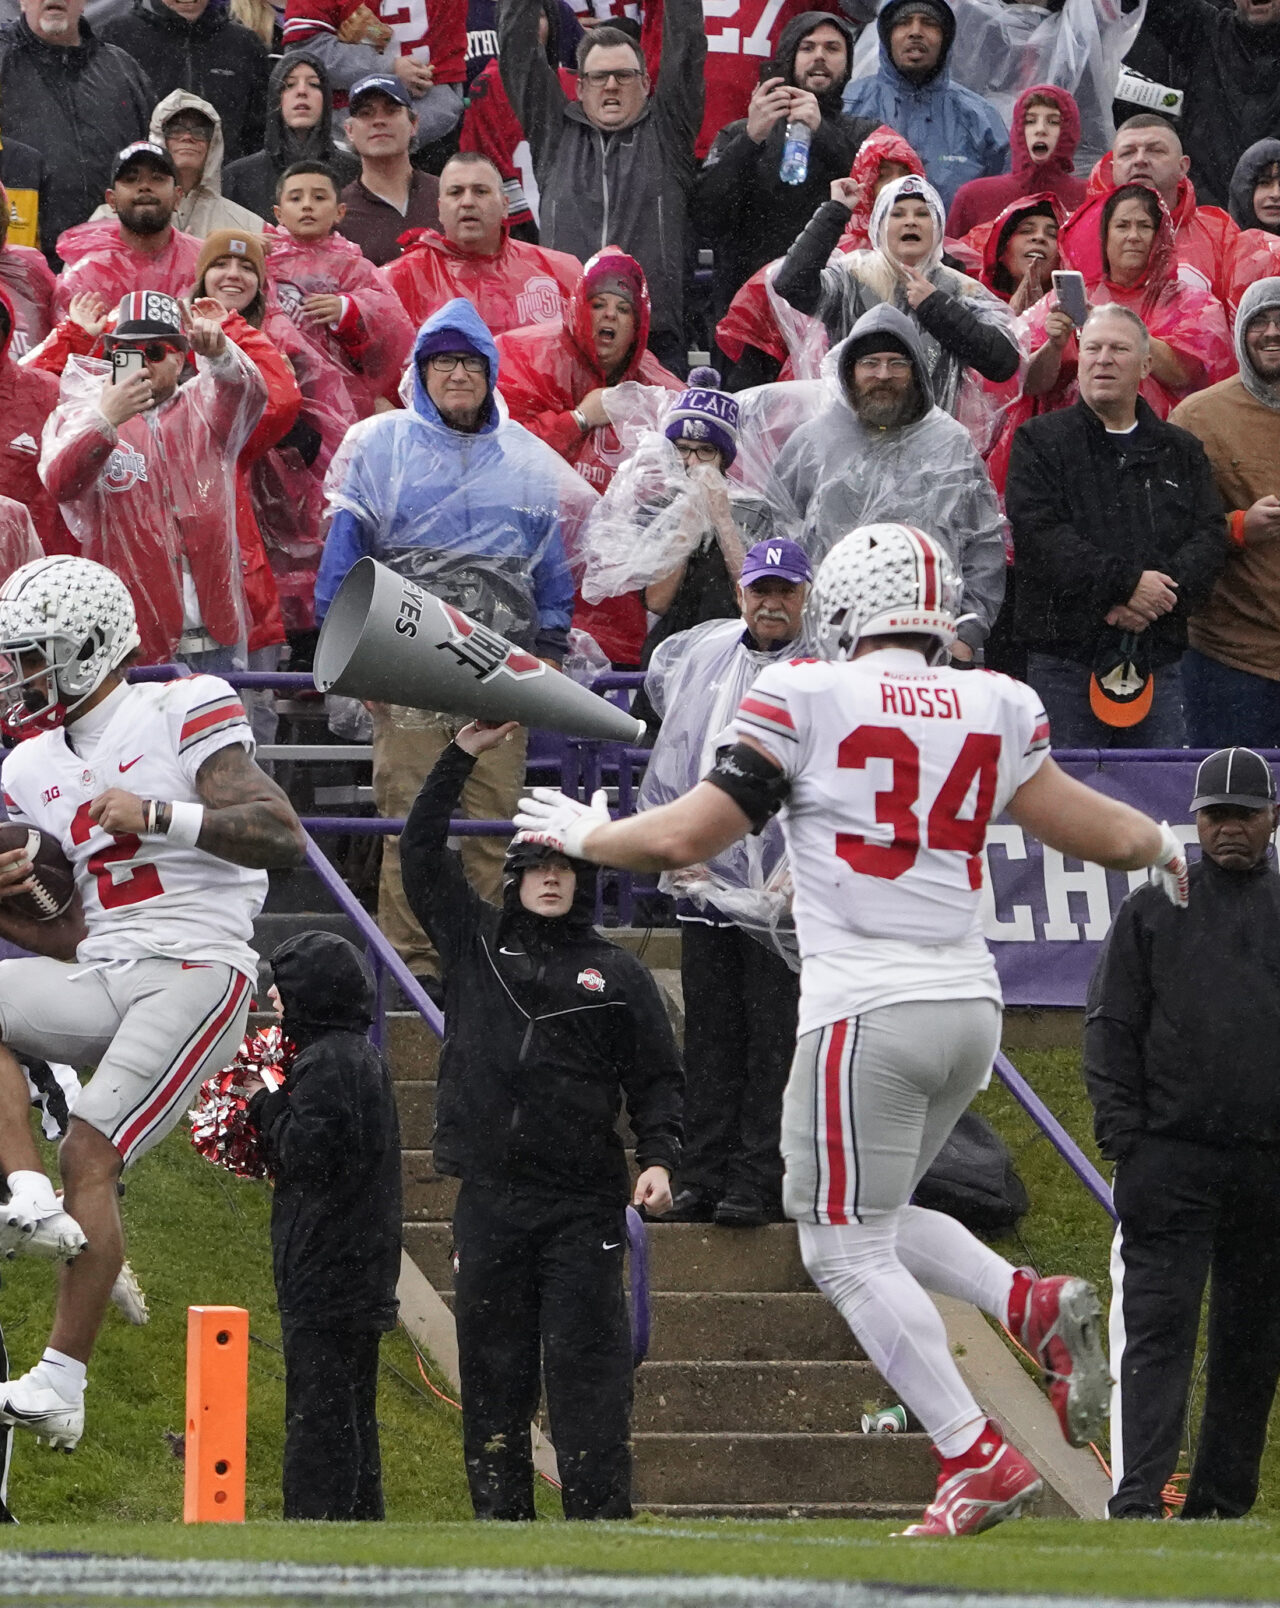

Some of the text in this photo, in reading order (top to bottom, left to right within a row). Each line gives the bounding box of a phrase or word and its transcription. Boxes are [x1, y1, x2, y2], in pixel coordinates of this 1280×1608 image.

[703, 0, 786, 57] 27
[766, 548, 783, 565] N
[880, 683, 962, 720] ROSSI
[835, 724, 1002, 891] 34
[70, 799, 165, 910] 2
